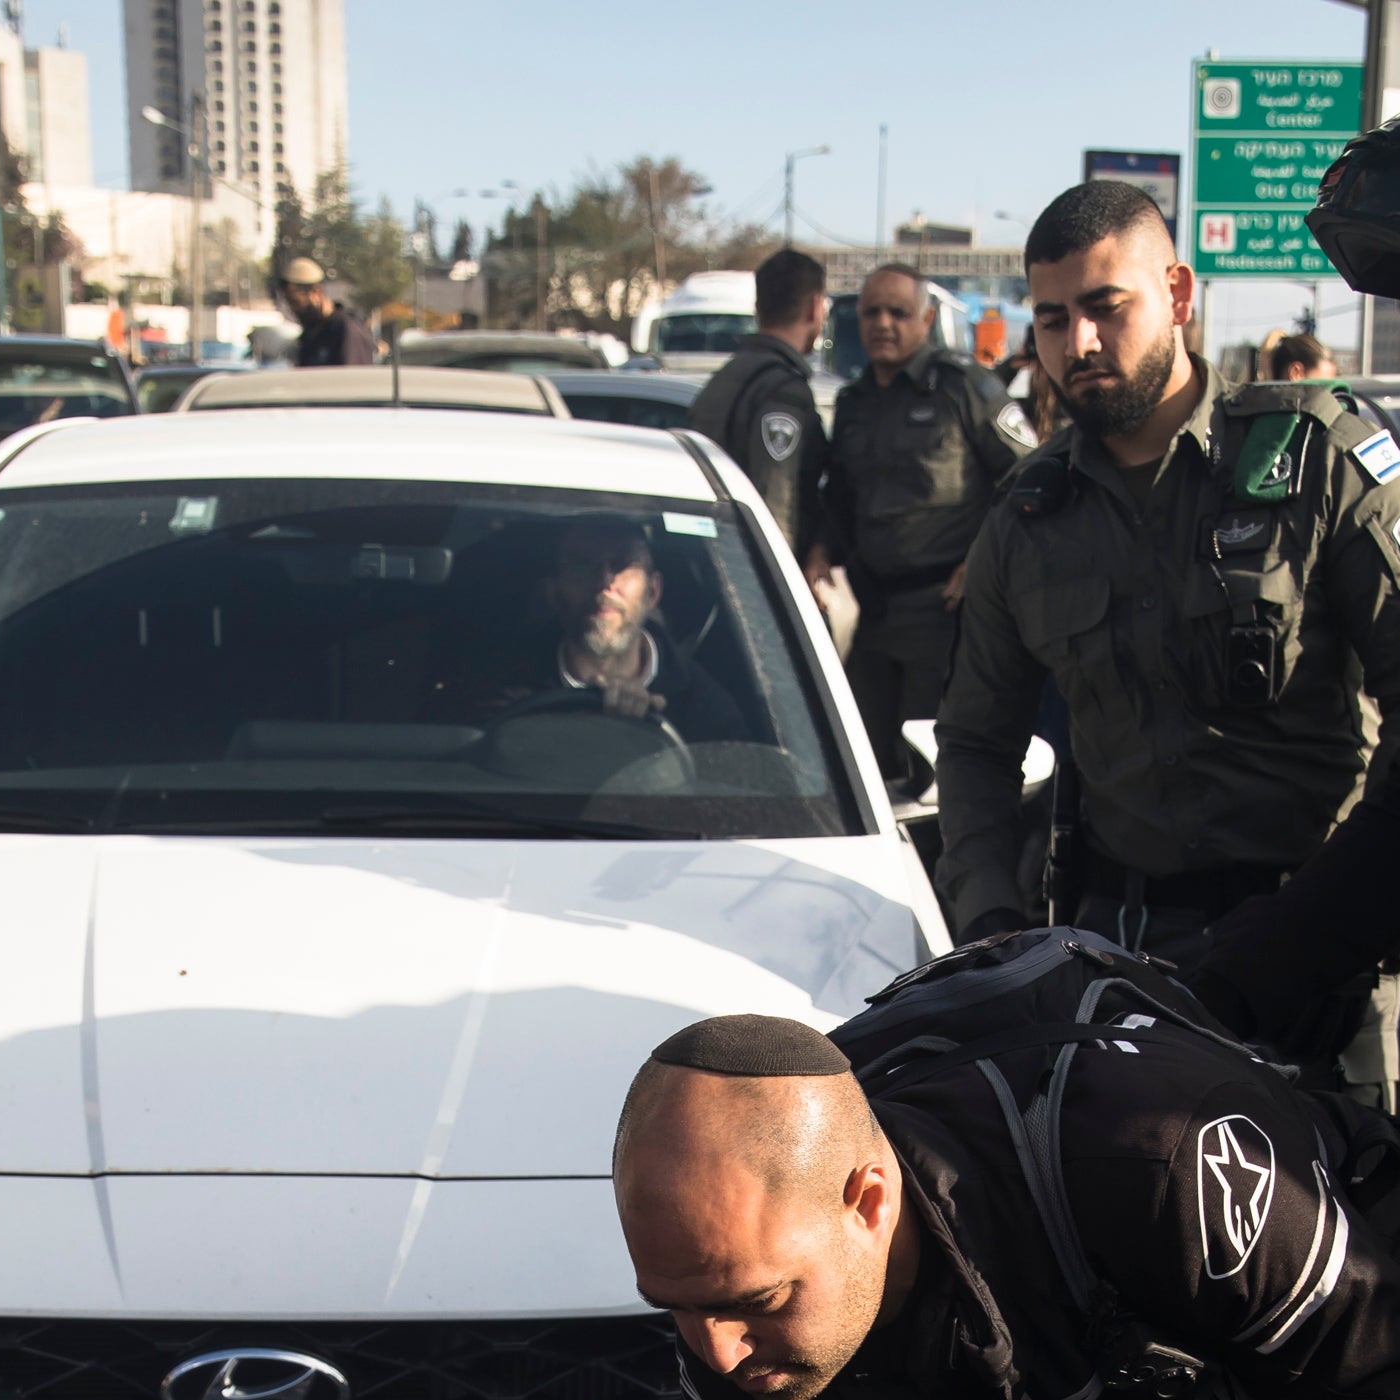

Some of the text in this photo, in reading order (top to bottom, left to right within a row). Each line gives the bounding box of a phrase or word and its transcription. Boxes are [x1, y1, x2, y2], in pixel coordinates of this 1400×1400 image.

[1251, 69, 1344, 88] מרכז העיר
[1265, 111, 1323, 128] Center
[1233, 141, 1348, 161] עיר העתיקה
[1255, 181, 1319, 200] Old Cit
[1300, 254, 1324, 271] En
